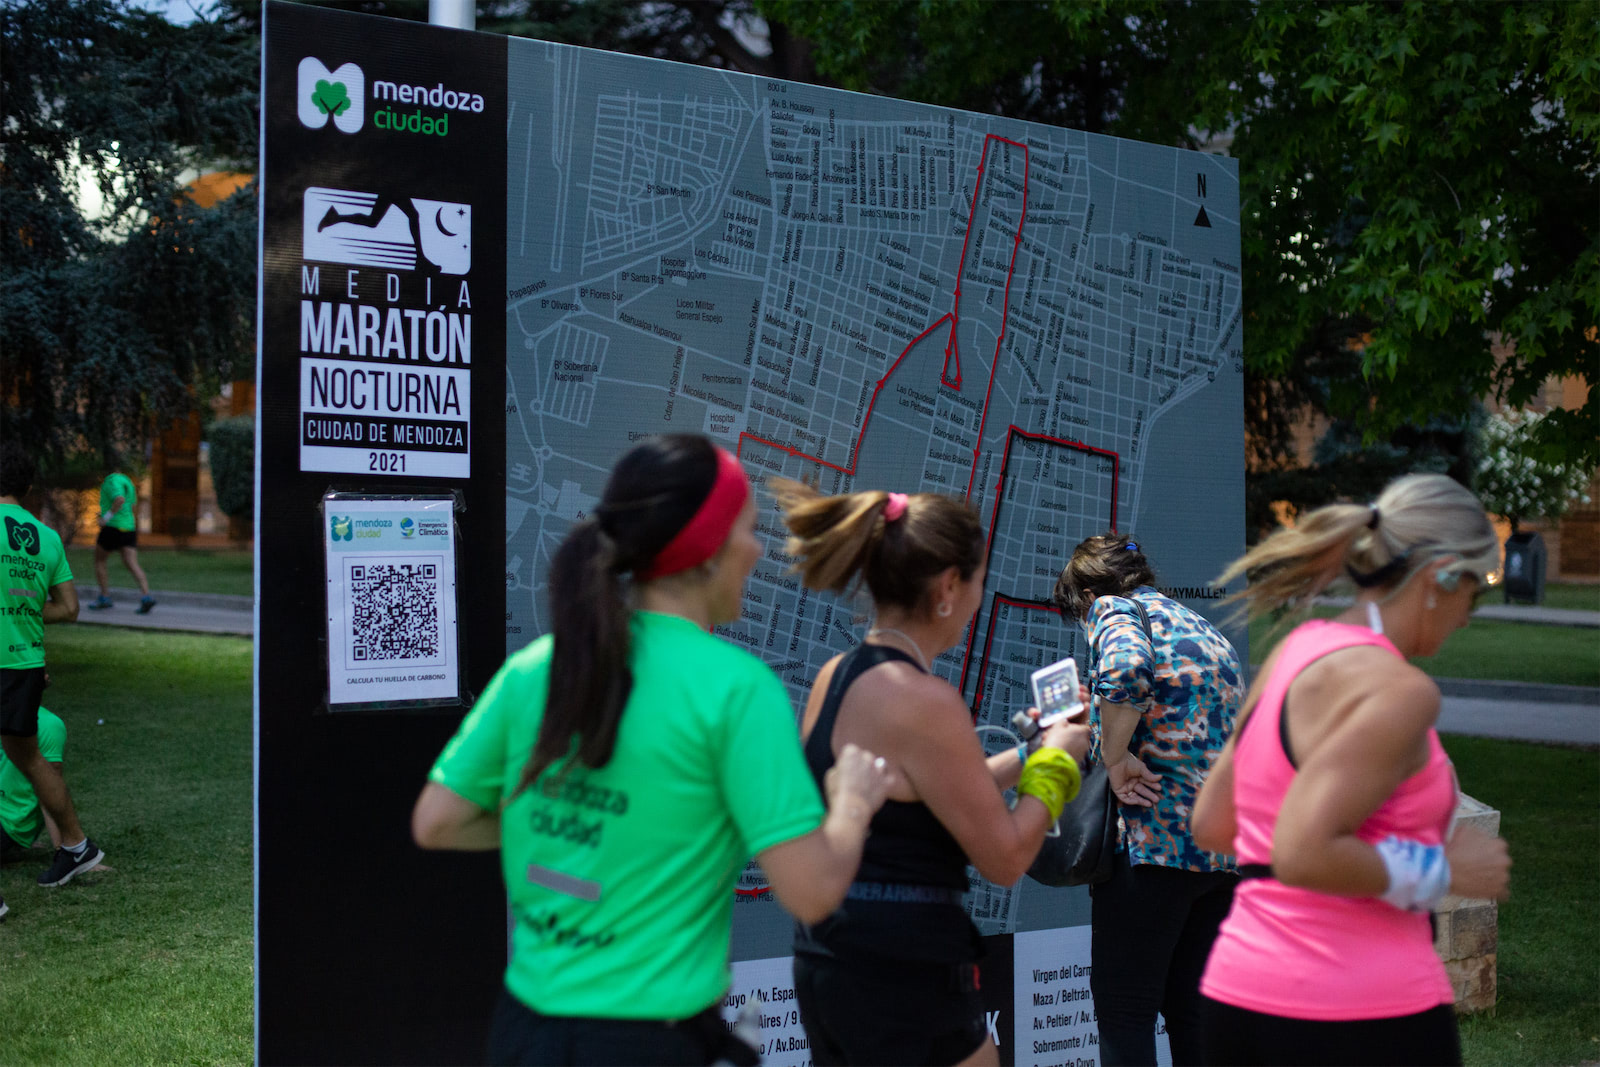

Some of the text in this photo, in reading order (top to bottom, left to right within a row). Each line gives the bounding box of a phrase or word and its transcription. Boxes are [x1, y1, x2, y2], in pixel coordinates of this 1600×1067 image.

[374, 80, 485, 113] mendoza
[374, 106, 449, 137] ciudad
[656, 186, 669, 195] San
[1197, 173, 1206, 198] N
[660, 256, 686, 267] Hospital
[509, 280, 547, 299] Papagayos
[589, 290, 610, 300] Flores
[551, 301, 579, 311] Olivares
[676, 298, 715, 311] Liceo Militar
[676, 310, 723, 324] General Espejo
[301, 299, 471, 364] MARATÓN
[554, 372, 584, 382] Nacional
[311, 366, 461, 416] NOCTURNA
[710, 412, 735, 424] Hospital
[308, 419, 463, 446] CIUDAD DE MENDOZA
[710, 423, 730, 434] Militar
[369, 452, 406, 472] 2021
[355, 518, 392, 528] mendoza
[355, 529, 382, 538] ciudad
[746, 592, 761, 603] Roca
[742, 608, 762, 622] Zapata
[417, 673, 446, 681] CARBONO
[1032, 968, 1058, 984] Virgen
[1059, 965, 1072, 979] del
[1033, 993, 1053, 1007] Maza
[1062, 987, 1090, 1003] Beltrán
[758, 1015, 781, 1029] Aires
[1033, 1016, 1045, 1031] Av.
[1046, 1013, 1072, 1028] Peltier
[1080, 1010, 1092, 1024] Av.
[1033, 1035, 1081, 1054] Sobremonte
